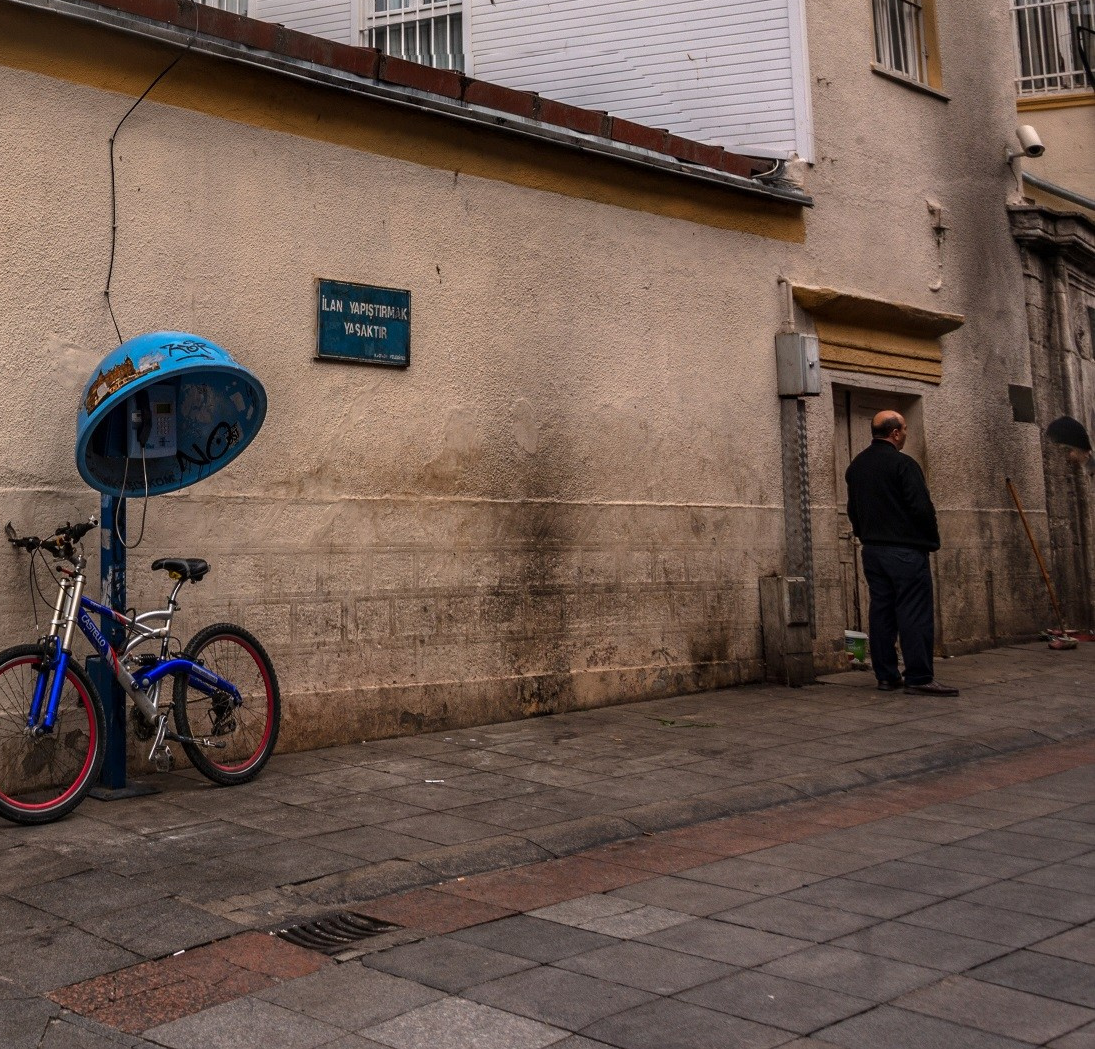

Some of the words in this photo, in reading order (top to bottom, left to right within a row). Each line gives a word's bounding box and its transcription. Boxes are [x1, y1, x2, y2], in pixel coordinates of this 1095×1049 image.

[321, 295, 343, 312] İLAN
[349, 301, 408, 320] YAPIŞTIRMAK
[343, 321, 387, 339] YASAKTIR
[80, 614, 106, 648] CASTELLO
